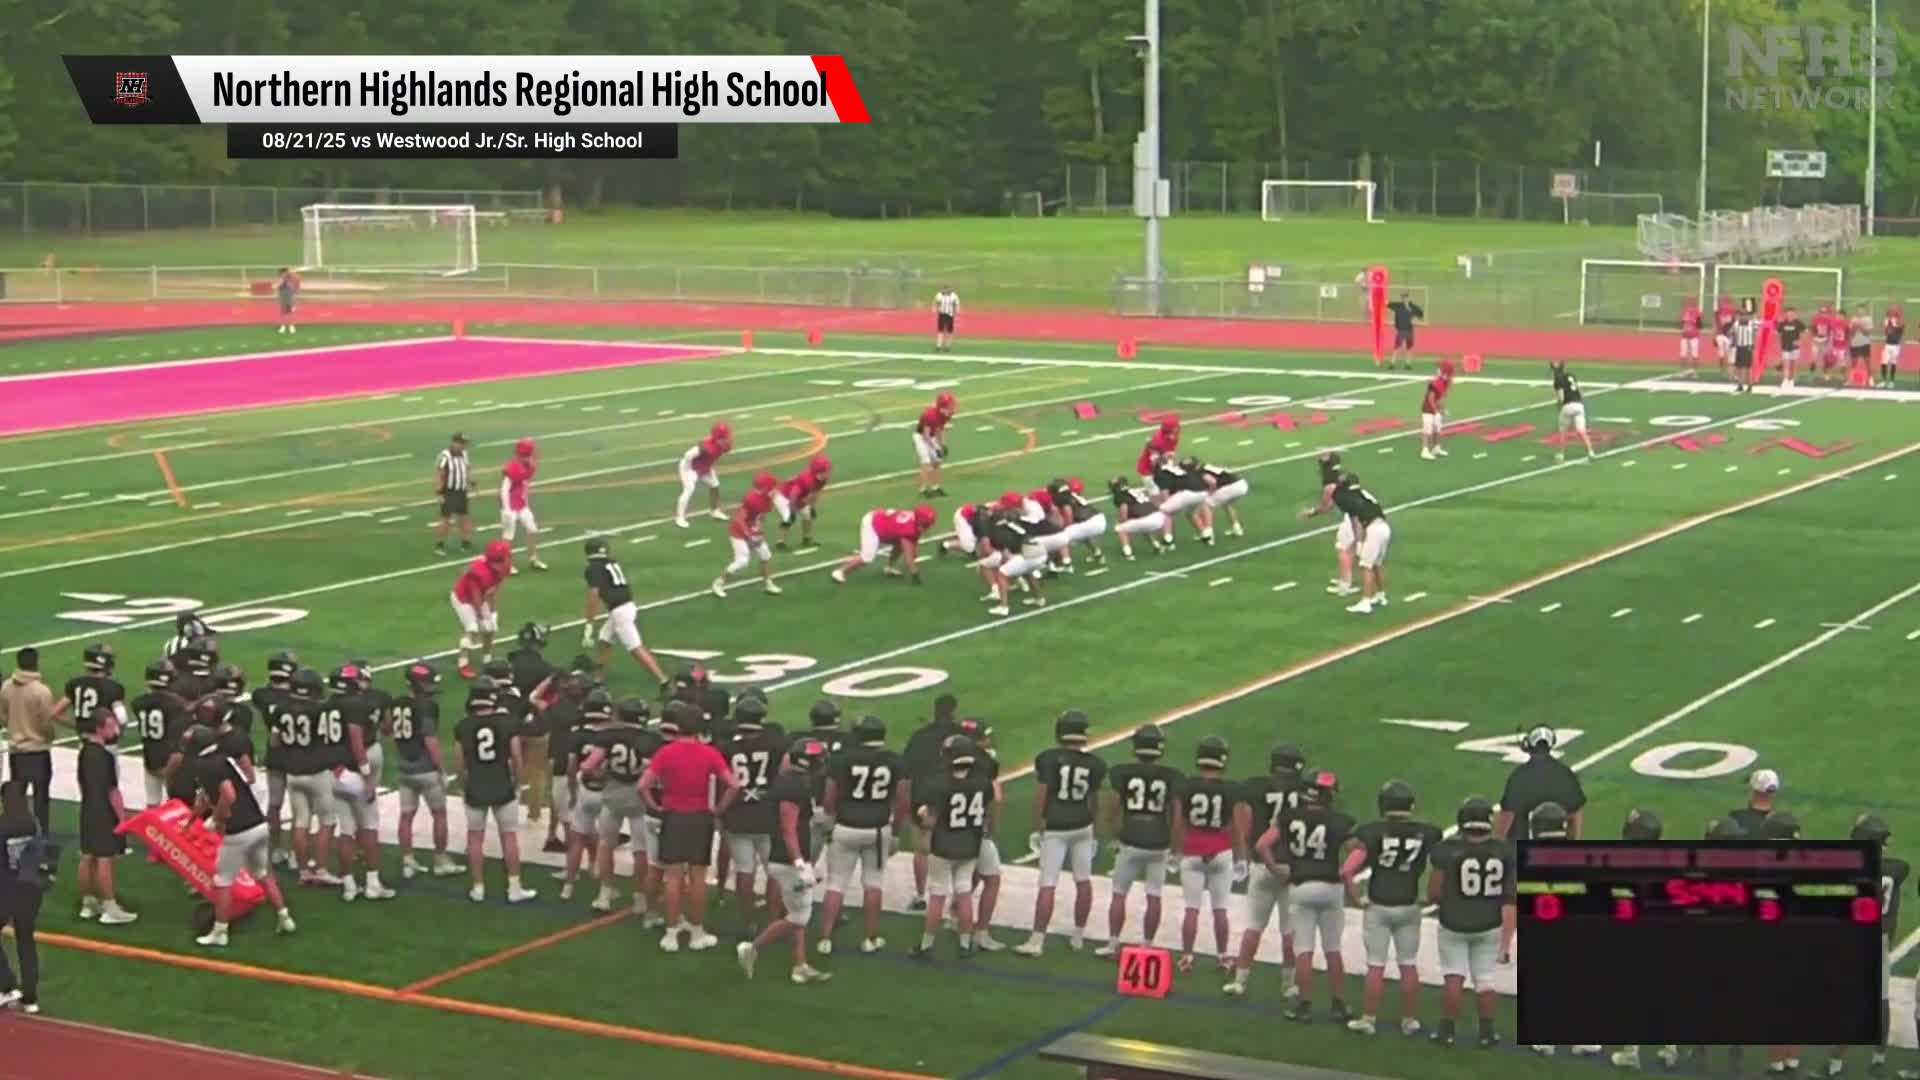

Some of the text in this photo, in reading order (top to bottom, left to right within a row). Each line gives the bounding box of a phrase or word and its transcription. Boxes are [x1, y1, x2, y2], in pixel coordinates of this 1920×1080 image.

[605, 563, 626, 585] 11
[55, 597, 310, 632] 20
[705, 653, 949, 697] 30
[74, 686, 98, 718] 12
[138, 709, 164, 740] 19
[280, 713, 311, 747] 33
[317, 709, 342, 744] 46
[392, 706, 412, 739] 26
[477, 728, 497, 760] 2
[731, 752, 769, 788] 67
[851, 765, 891, 799] 72
[1058, 765, 1090, 800] 15
[950, 791, 984, 828] 24
[1127, 778, 1167, 812] 33
[1190, 793, 1223, 828] 21
[1288, 819, 1327, 860] 34
[1378, 836, 1423, 872] 57
[1460, 857, 1504, 896] 62
[1123, 953, 1162, 990] 40
